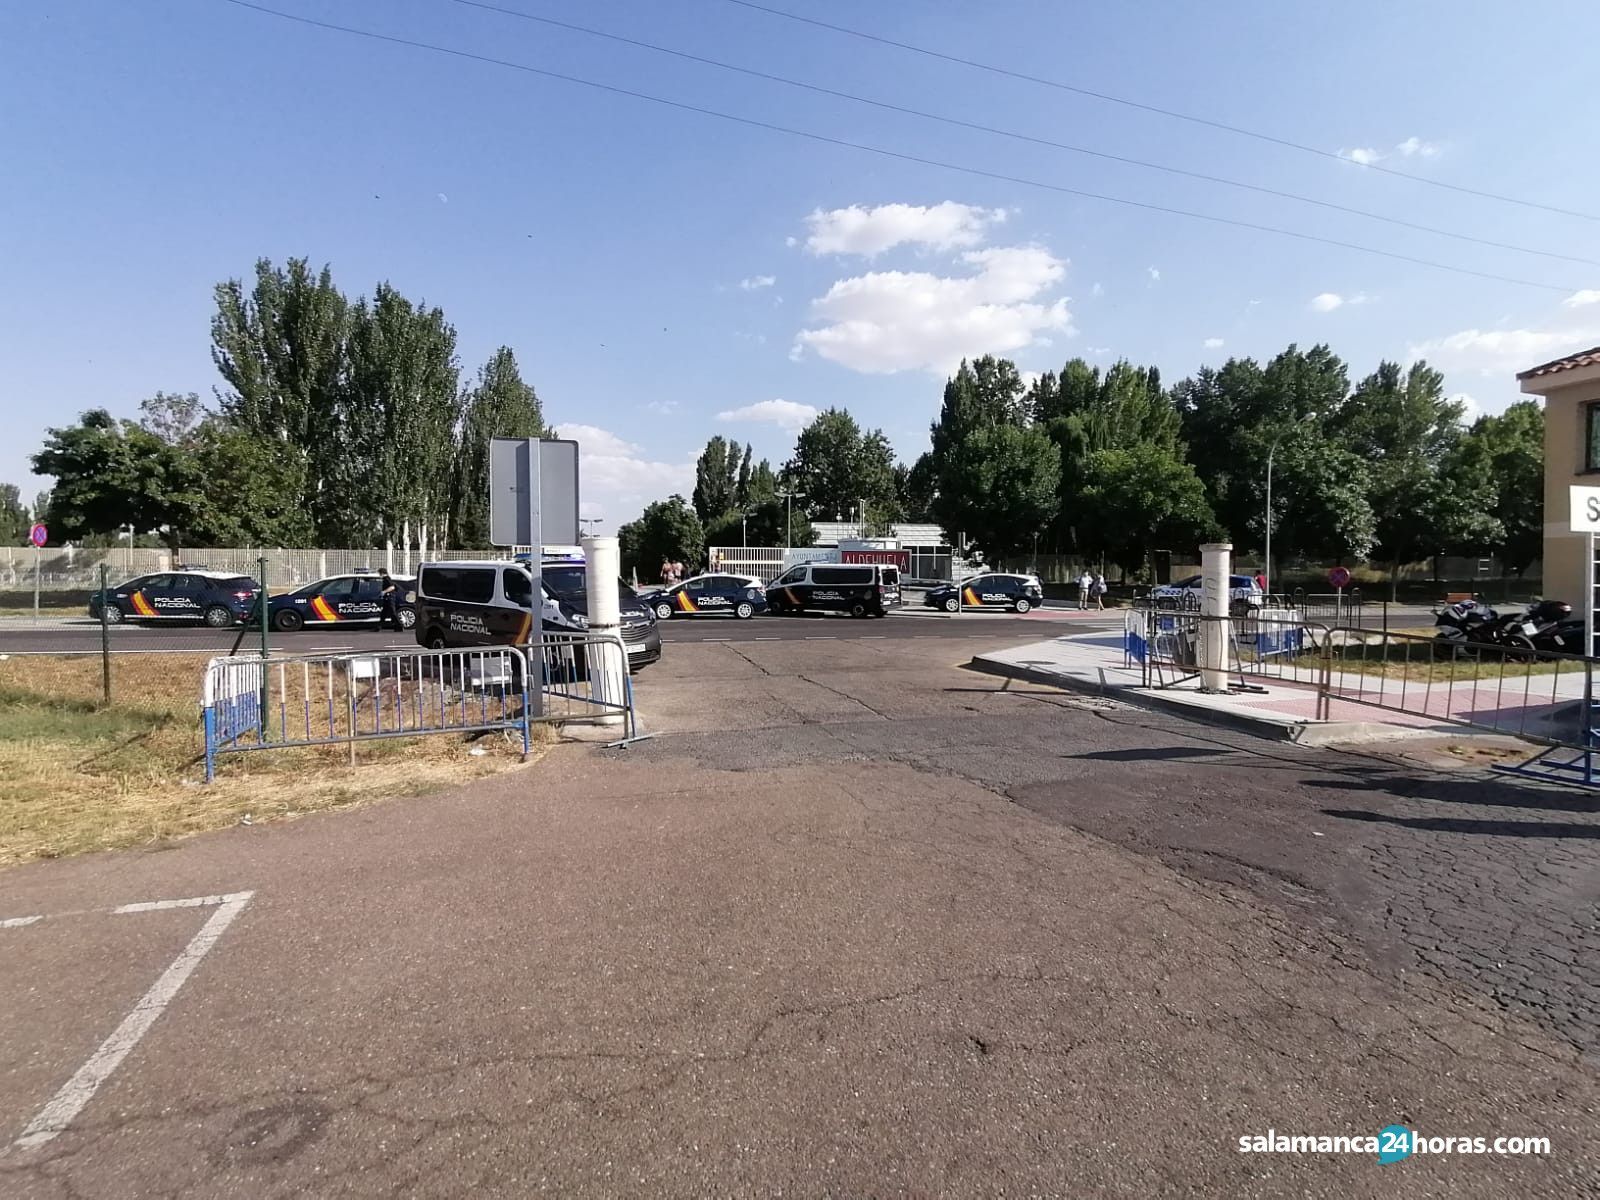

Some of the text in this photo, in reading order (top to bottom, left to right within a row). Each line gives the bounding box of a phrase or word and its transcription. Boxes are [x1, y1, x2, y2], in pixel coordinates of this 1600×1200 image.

[1586, 496, 1600, 523] S
[450, 614, 484, 625] POLICIA
[450, 622, 492, 636] NACIONAL
